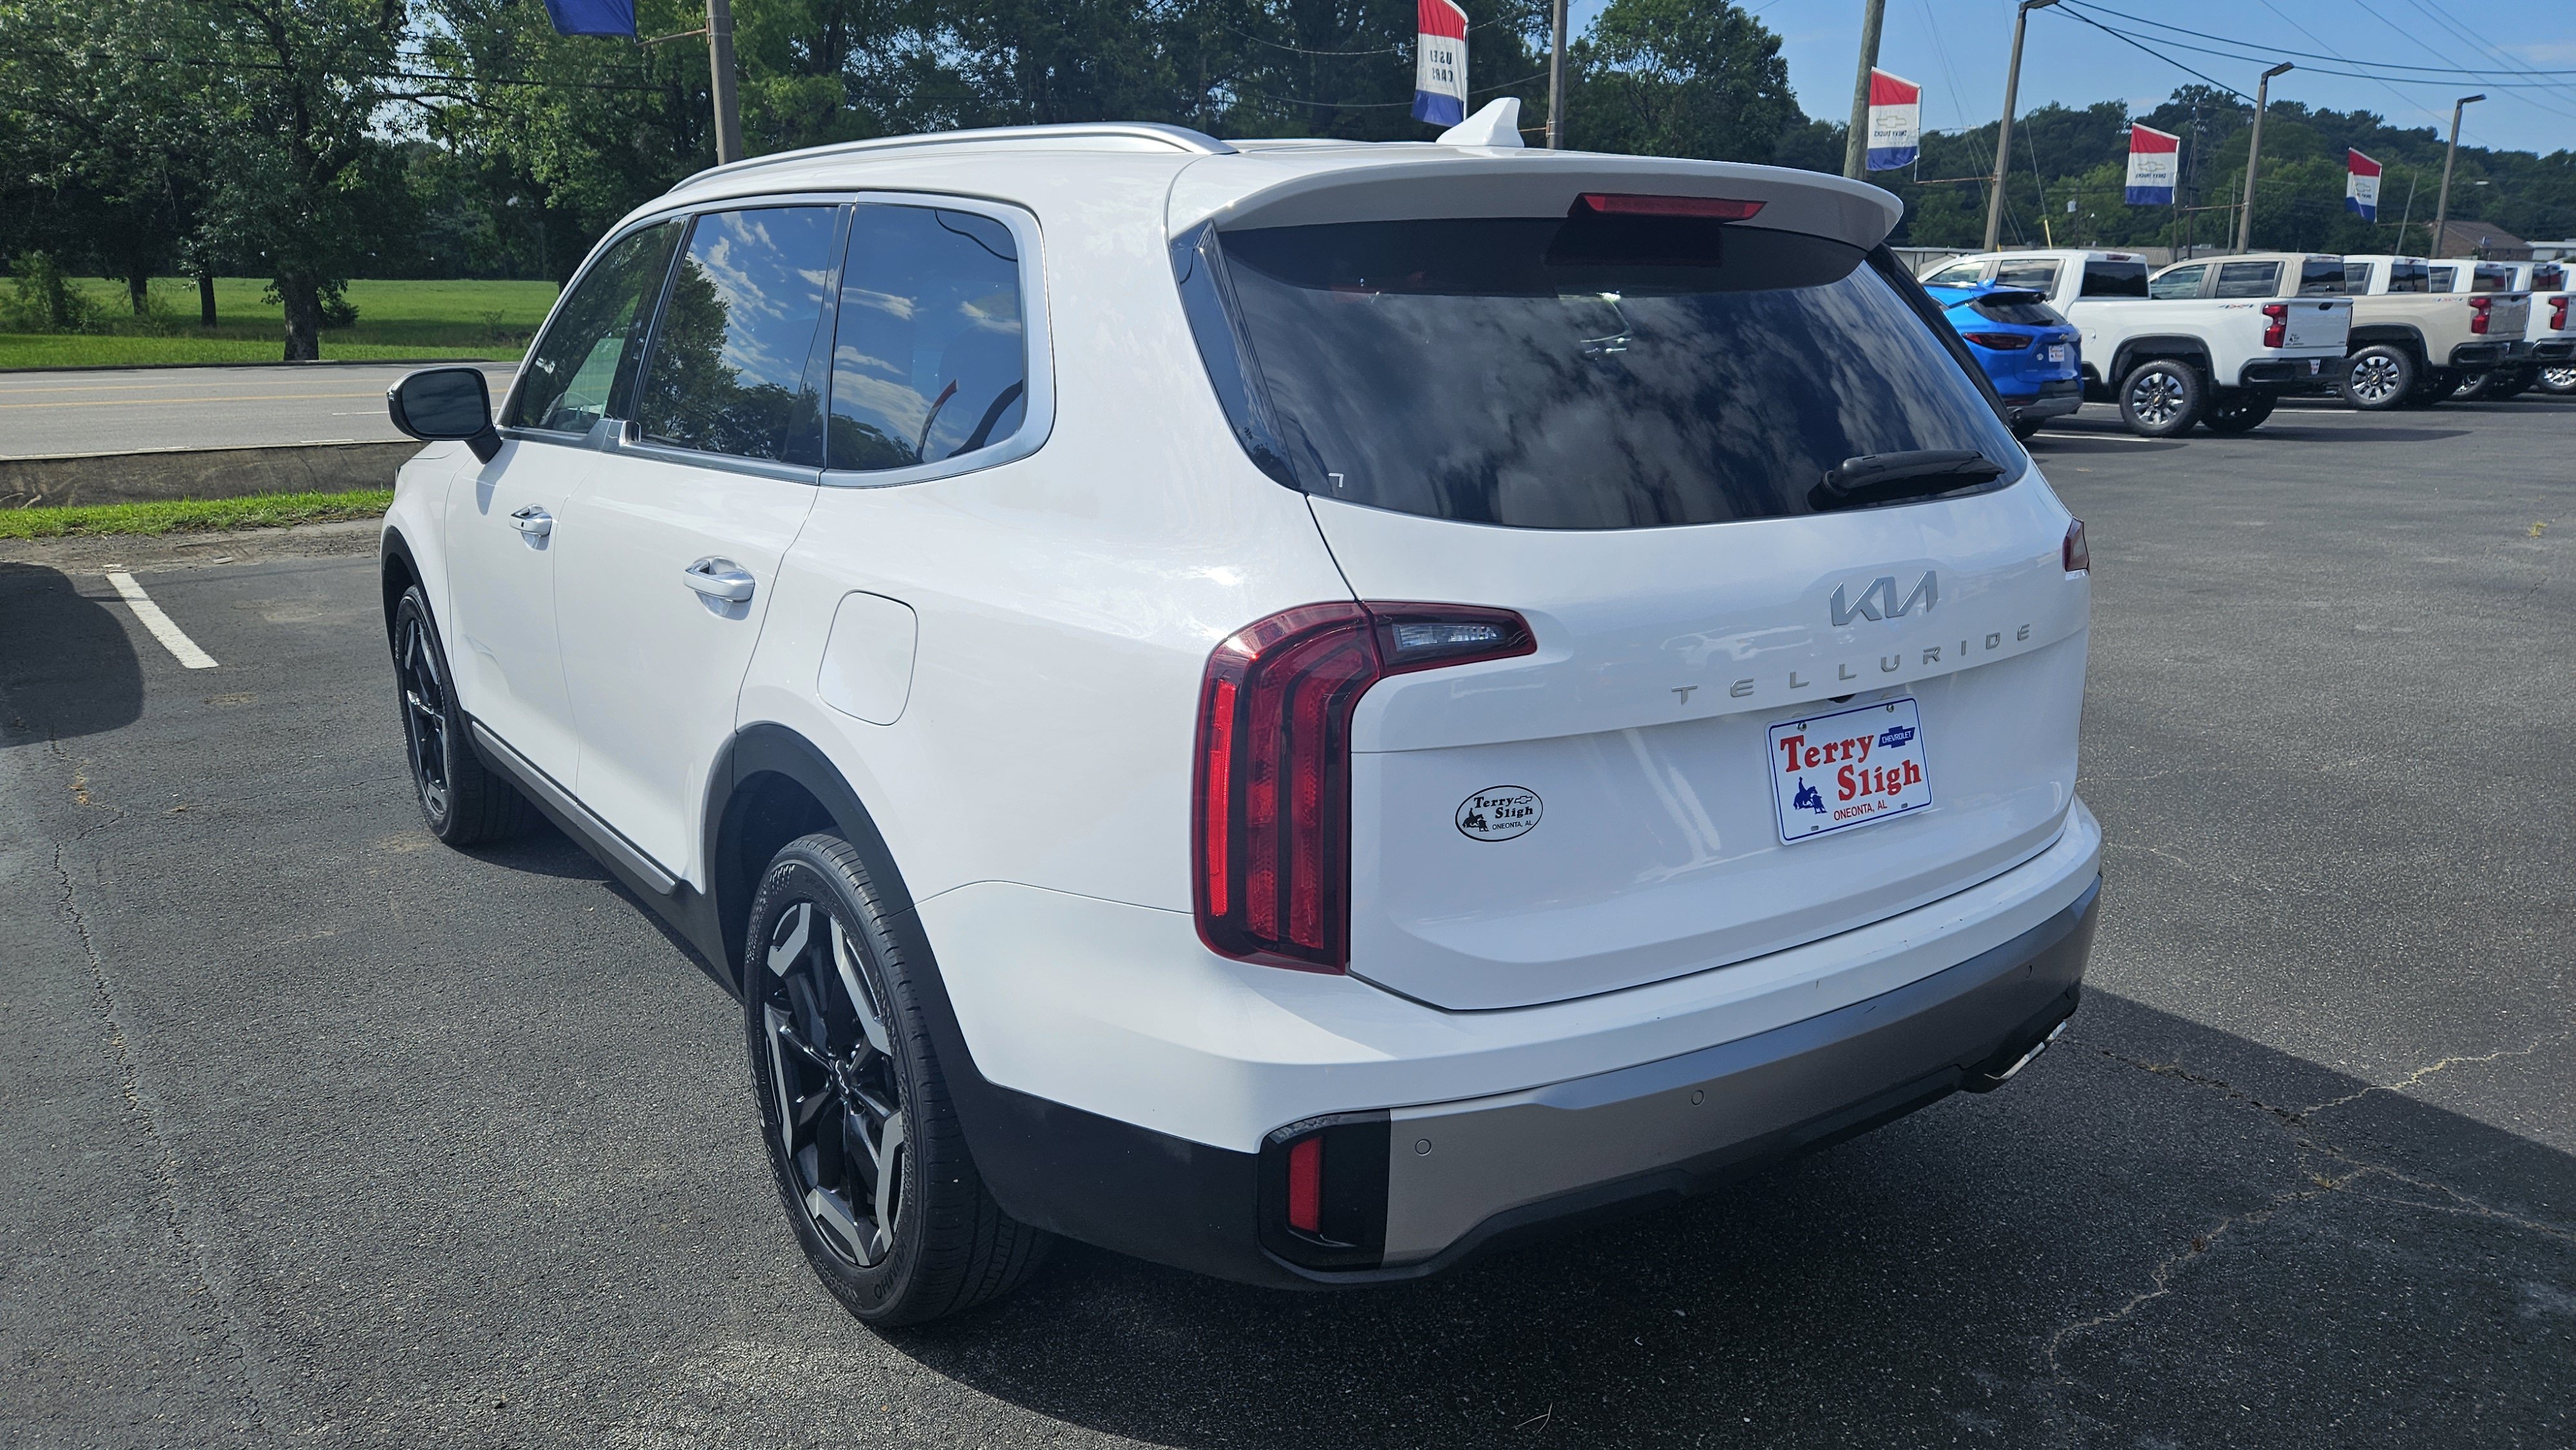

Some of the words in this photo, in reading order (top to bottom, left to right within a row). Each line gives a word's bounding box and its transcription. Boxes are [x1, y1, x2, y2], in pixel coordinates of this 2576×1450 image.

[1671, 624, 2031, 705] TELLURIDE
[1882, 730, 1912, 744] CHEVROLET
[1780, 735, 1875, 772] Terry
[1837, 759, 1922, 801] Sligh
[1473, 796, 1514, 809] Terry
[1833, 803, 1875, 821] ONEONTA,
[1877, 800, 1888, 809] AL
[1495, 806, 1533, 819] Sligh
[1492, 822, 1522, 830] ONEONTA,
